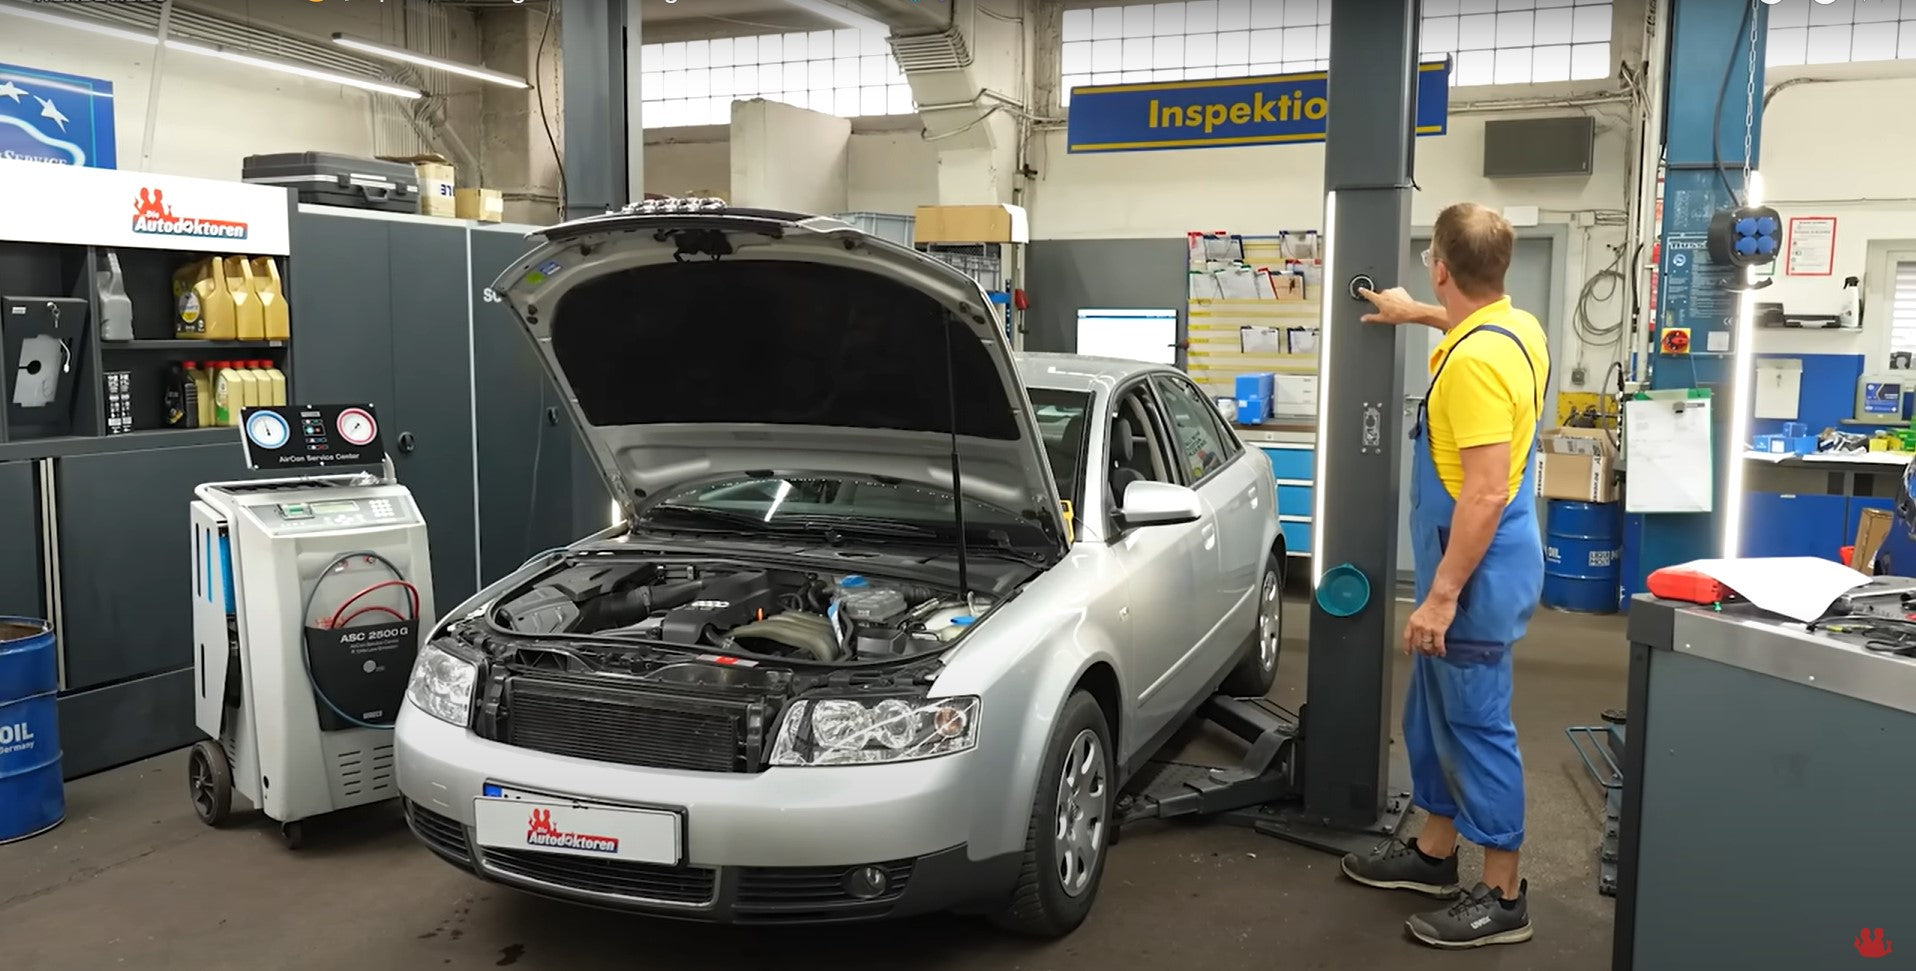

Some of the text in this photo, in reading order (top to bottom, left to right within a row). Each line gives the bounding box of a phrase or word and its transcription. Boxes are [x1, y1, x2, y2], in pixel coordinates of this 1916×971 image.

[134, 216, 244, 237] Autodoktoren
[279, 452, 360, 463] AirCon Service Center
[340, 626, 409, 643] ASC 2500 G
[0, 723, 34, 743] OIL
[529, 831, 614, 850] Autodoktoren
